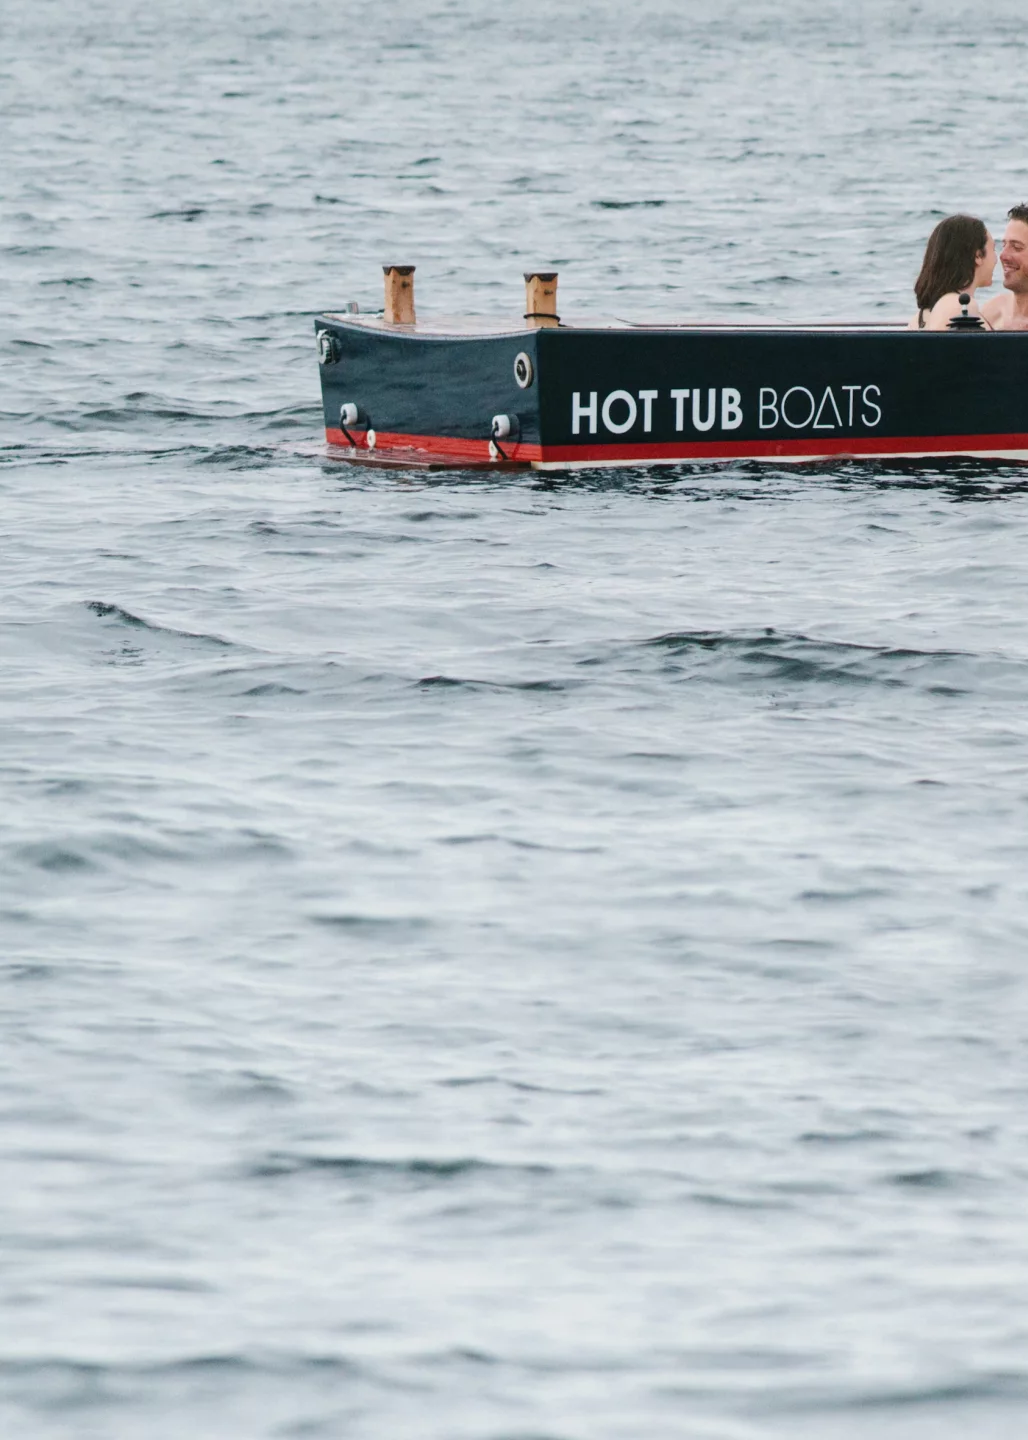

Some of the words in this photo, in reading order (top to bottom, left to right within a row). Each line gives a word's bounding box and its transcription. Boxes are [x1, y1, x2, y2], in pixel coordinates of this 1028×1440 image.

[572, 390, 658, 434] HOT
[671, 388, 743, 431] TUB
[759, 385, 881, 428] BOATS
